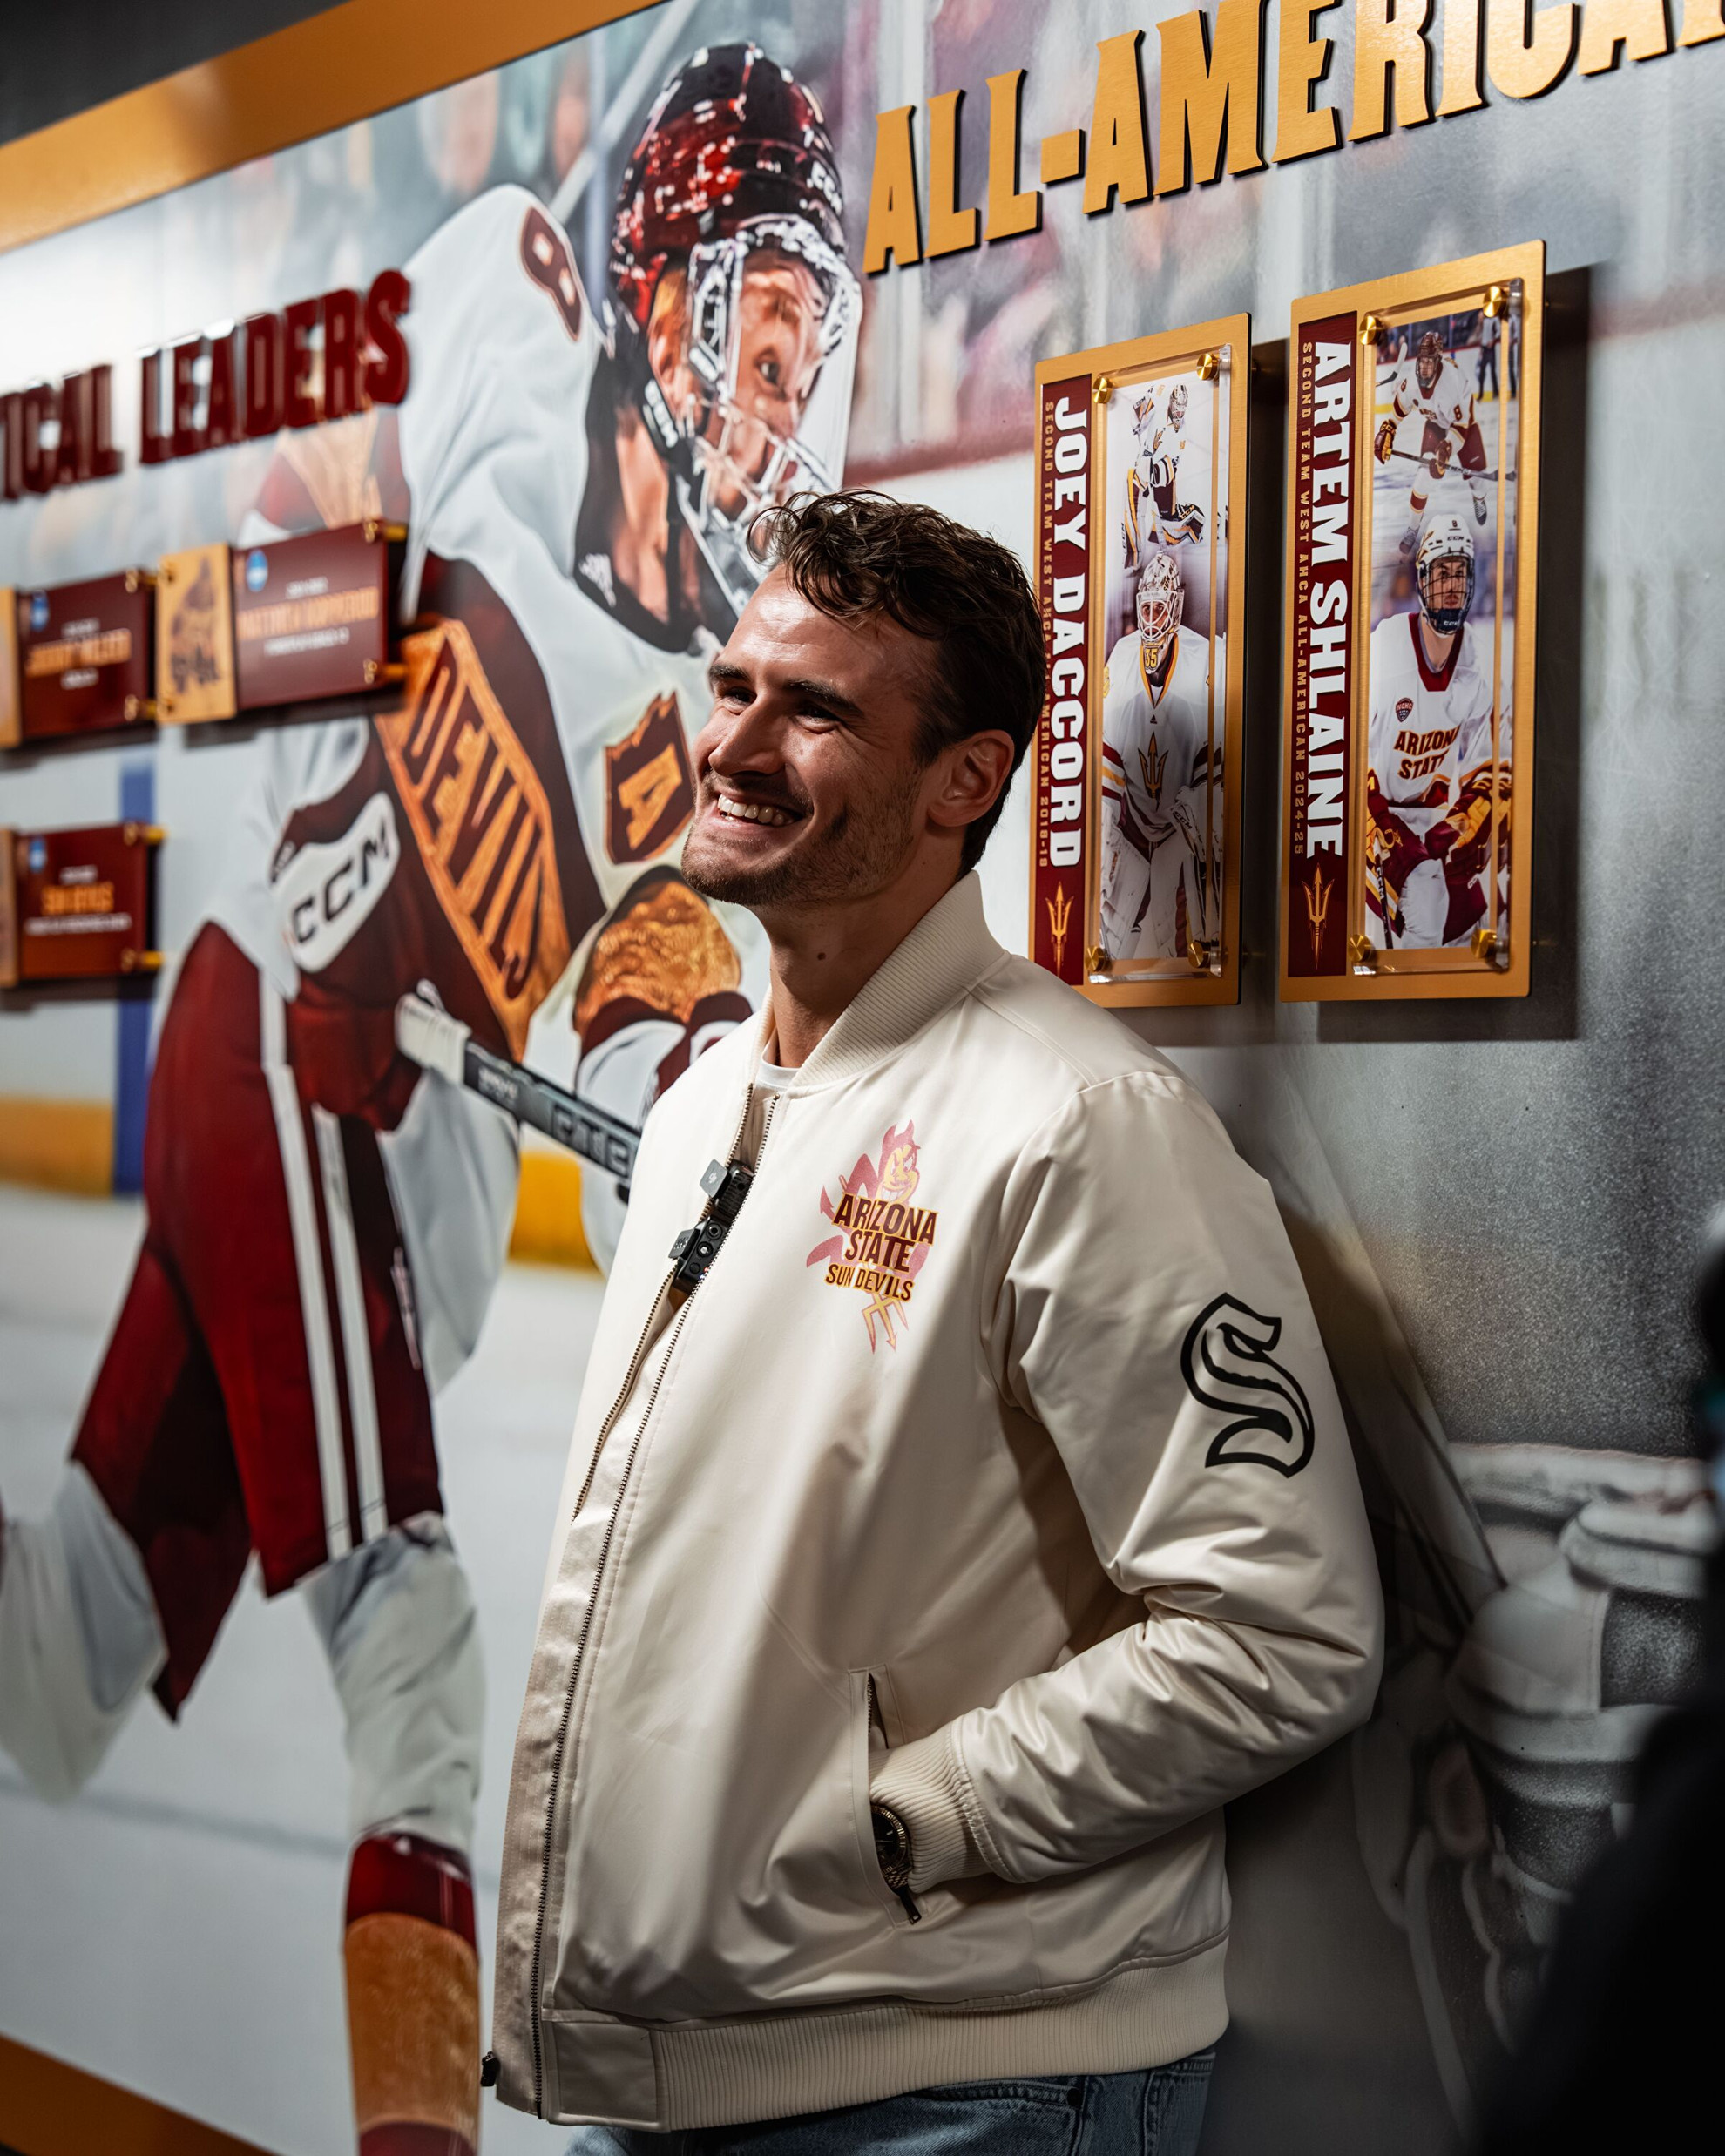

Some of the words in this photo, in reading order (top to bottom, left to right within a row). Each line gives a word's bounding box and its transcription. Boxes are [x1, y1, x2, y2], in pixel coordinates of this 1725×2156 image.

[0, 363, 124, 502] ICAL
[139, 269, 411, 467] LEADERS
[1302, 341, 1313, 418] SECOND
[1045, 401, 1054, 471] SECOND
[1300, 427, 1311, 481] TEAM
[1312, 341, 1351, 566] ARTEM
[1044, 480, 1053, 529] TEAM
[1054, 396, 1087, 551] JOEY
[1299, 490, 1310, 542] WEST
[1043, 537, 1052, 585] WEST
[1298, 553, 1309, 604] AHCA
[1144, 646, 1159, 669] 35
[1296, 614, 1308, 761] ALL-AMERICAN
[1050, 572, 1086, 868] DACCORD
[1307, 579, 1348, 859] SHLAINE
[1393, 724, 1461, 756] ARIZON
[618, 742, 682, 851] A
[1295, 770, 1305, 855] 2024-25
[292, 815, 389, 942] CCM
[831, 1192, 938, 1247] ARIZONA
[844, 1228, 917, 1274] STATE
[824, 1263, 856, 1288] SUN
[854, 1268, 916, 1302] DEVILS
